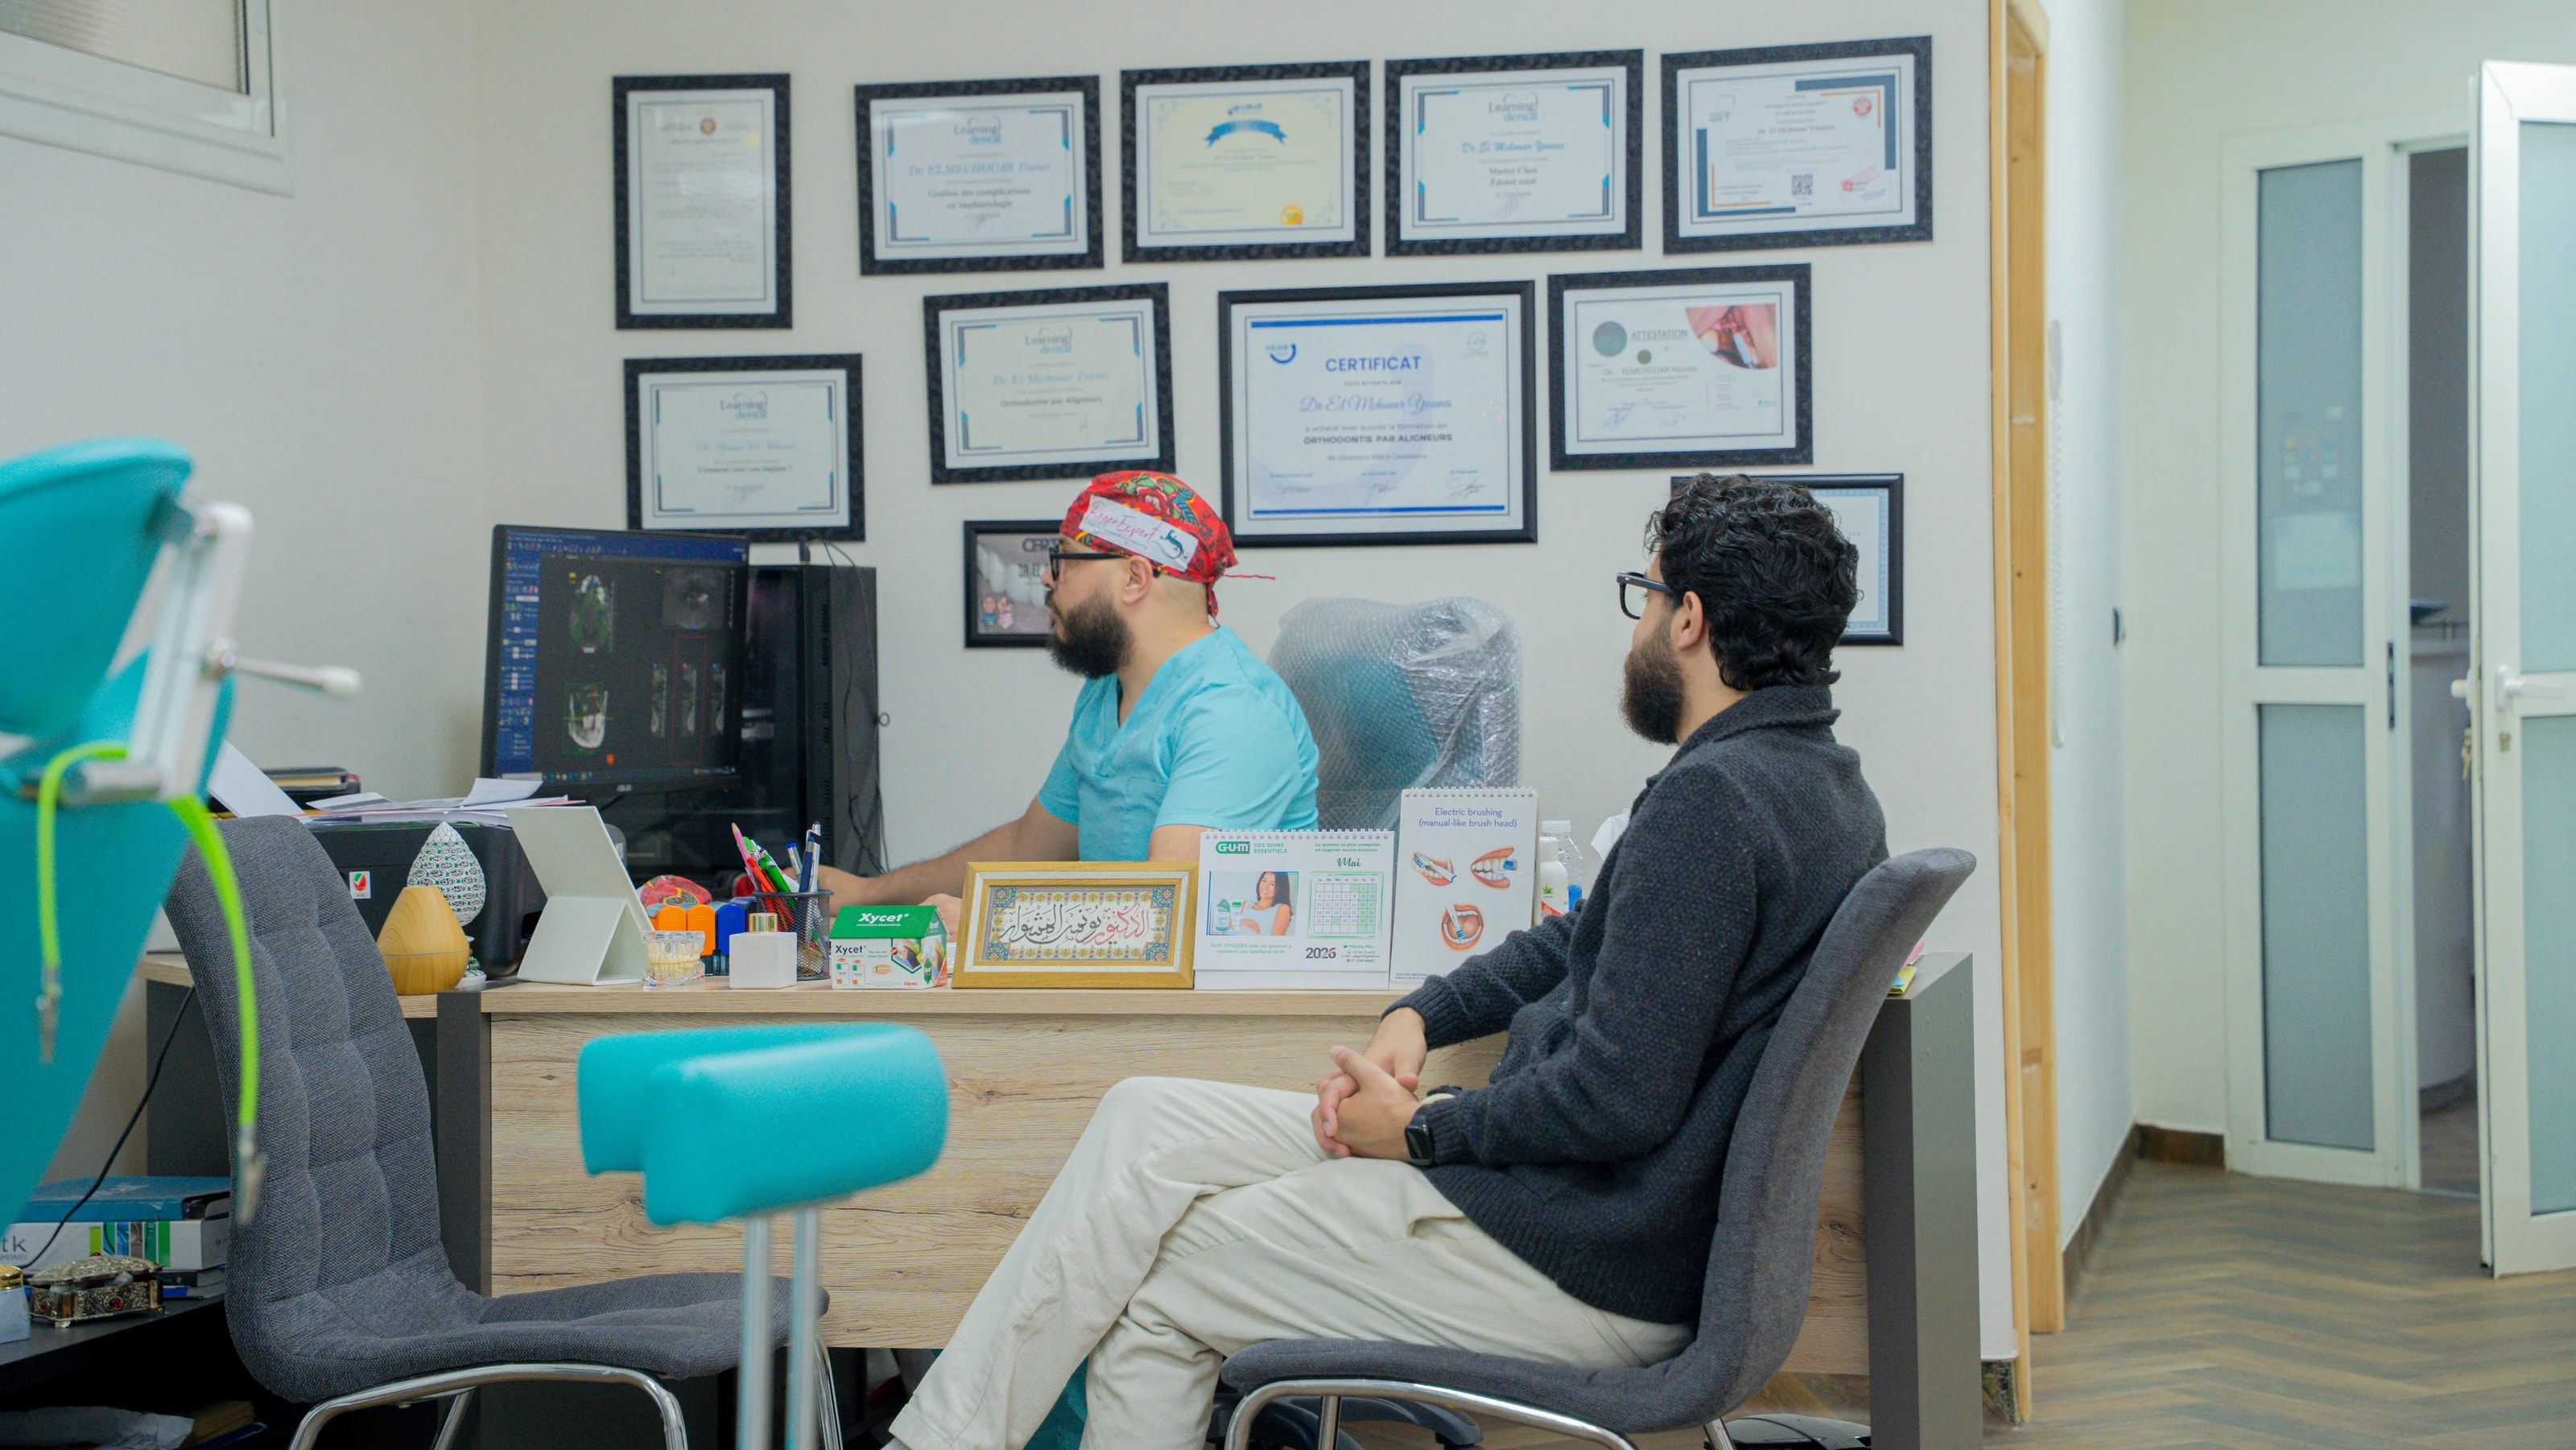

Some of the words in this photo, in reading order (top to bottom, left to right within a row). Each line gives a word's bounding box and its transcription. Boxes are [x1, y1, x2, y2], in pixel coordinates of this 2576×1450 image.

[1488, 101, 1534, 112] Learning
[953, 124, 997, 136] Learning
[1630, 328, 1688, 339] ATTESTATION
[1024, 335, 1069, 346] Learning
[1325, 356, 1421, 372] CERTIFICAT
[720, 399, 764, 411] Learning
[1299, 395, 1323, 412] Dr
[1325, 395, 1347, 411] El
[1303, 434, 1373, 445] ORTHODONTIE
[1376, 435, 1395, 443] PAR
[1397, 433, 1453, 442] ALIGNEURS
[1435, 807, 1466, 816] Electric
[1468, 808, 1503, 818] brushing
[1418, 818, 1467, 828] (manual-like
[1468, 819, 1492, 828] brush
[1494, 819, 1517, 828] head)
[1336, 857, 1361, 867] Mai
[858, 912, 903, 924] Xycet
[835, 944, 864, 955] Xycet
[1305, 947, 1336, 959] 2026
